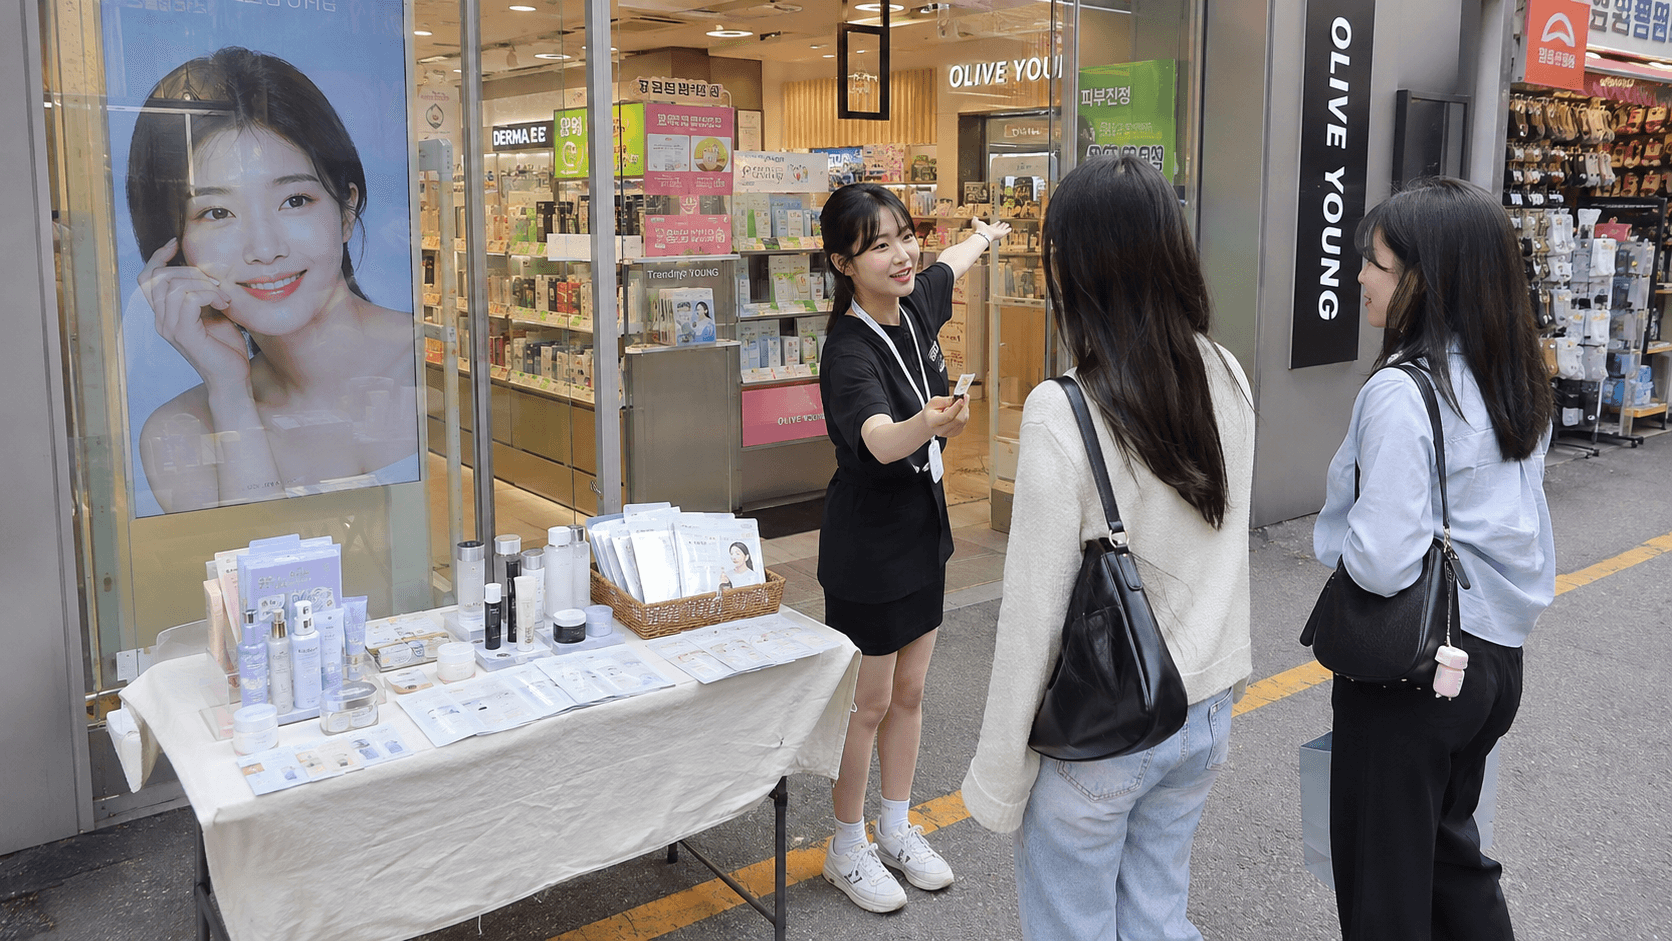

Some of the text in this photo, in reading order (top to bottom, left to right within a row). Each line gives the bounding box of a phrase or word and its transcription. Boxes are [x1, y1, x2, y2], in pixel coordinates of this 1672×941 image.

[949, 54, 1063, 88] OLIVE YOU
[1080, 86, 1131, 107] 피부진정
[493, 128, 530, 146] DERMA
[1318, 16, 1352, 320] OLIVE YOUNG
